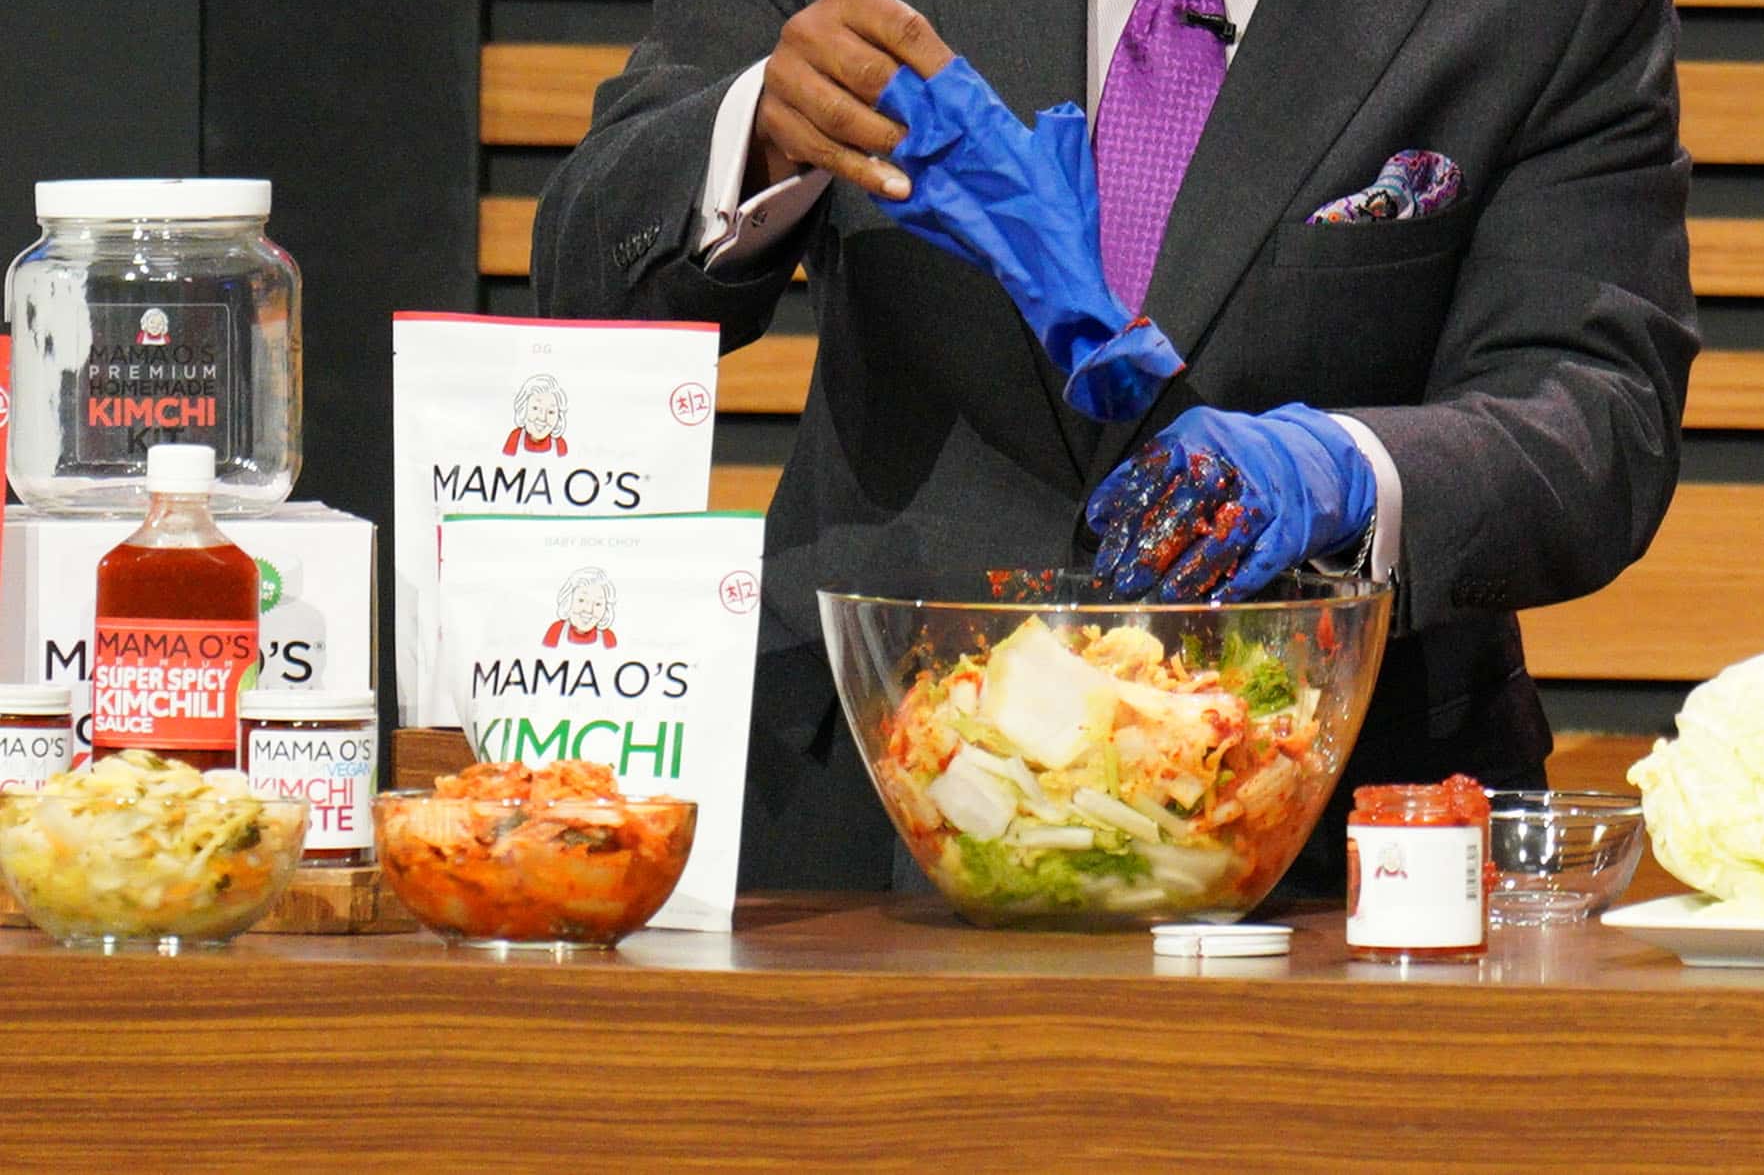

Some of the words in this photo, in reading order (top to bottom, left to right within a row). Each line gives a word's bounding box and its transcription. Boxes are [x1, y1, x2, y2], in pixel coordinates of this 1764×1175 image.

[89, 365, 217, 379] PREMIUM
[89, 379, 215, 396] HOMEMADE
[88, 397, 217, 427] KIMCHI
[433, 464, 553, 505] MAMA
[564, 468, 642, 510] O'S
[97, 631, 191, 659] MAMA
[199, 634, 250, 660] O'S
[95, 666, 164, 690] SUPER
[168, 668, 232, 692] SPICY
[472, 659, 601, 700] MAMA
[614, 661, 689, 699] O'S
[95, 689, 226, 719] KIMCHILI
[95, 715, 154, 734] SAUCE
[31, 737, 65, 758] O'S
[255, 739, 334, 761] MAMA
[339, 738, 371, 762] O'S
[472, 718, 685, 780] KIMCHI
